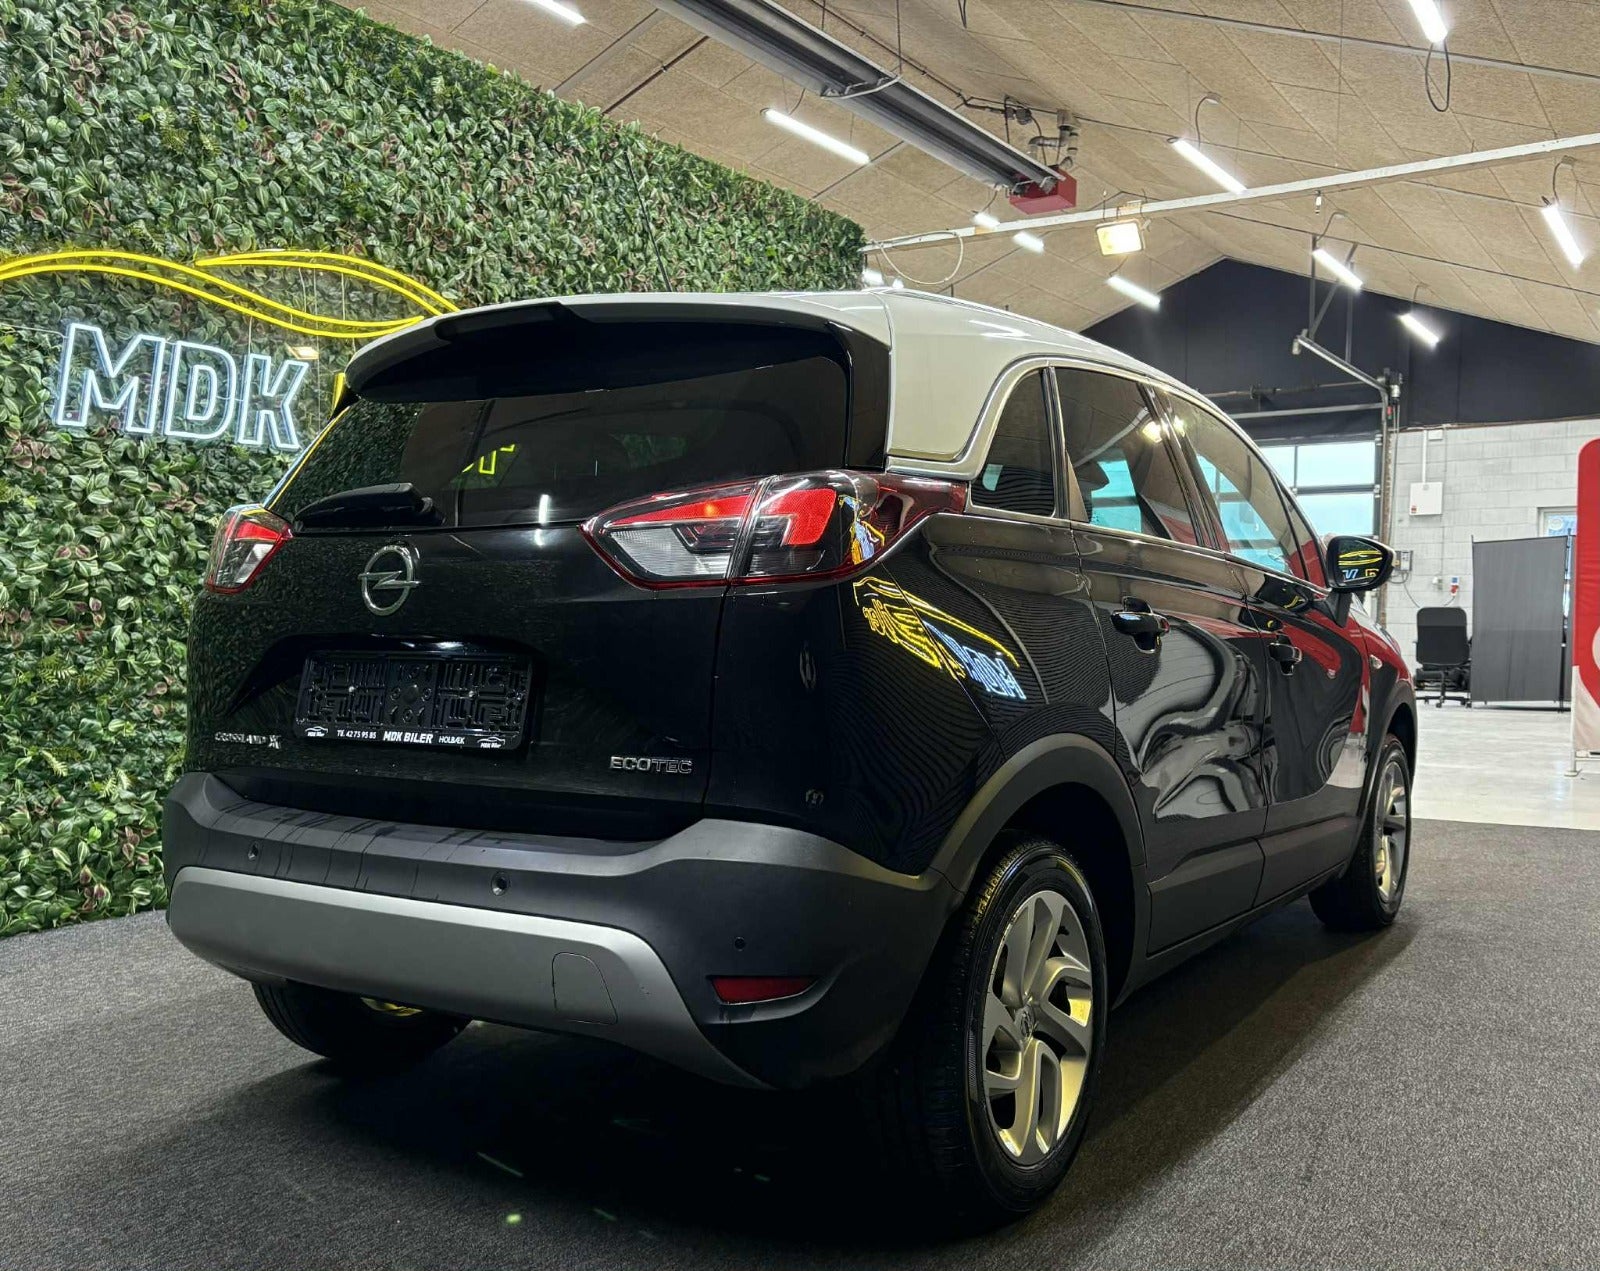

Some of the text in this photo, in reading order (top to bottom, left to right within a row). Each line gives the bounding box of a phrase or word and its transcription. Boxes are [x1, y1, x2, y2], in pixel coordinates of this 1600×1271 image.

[54, 322, 309, 449] MDK
[346, 730, 354, 738] 42
[383, 731, 403, 742] MDK
[404, 732, 433, 744] BILER
[610, 756, 693, 774] ECOTEC
